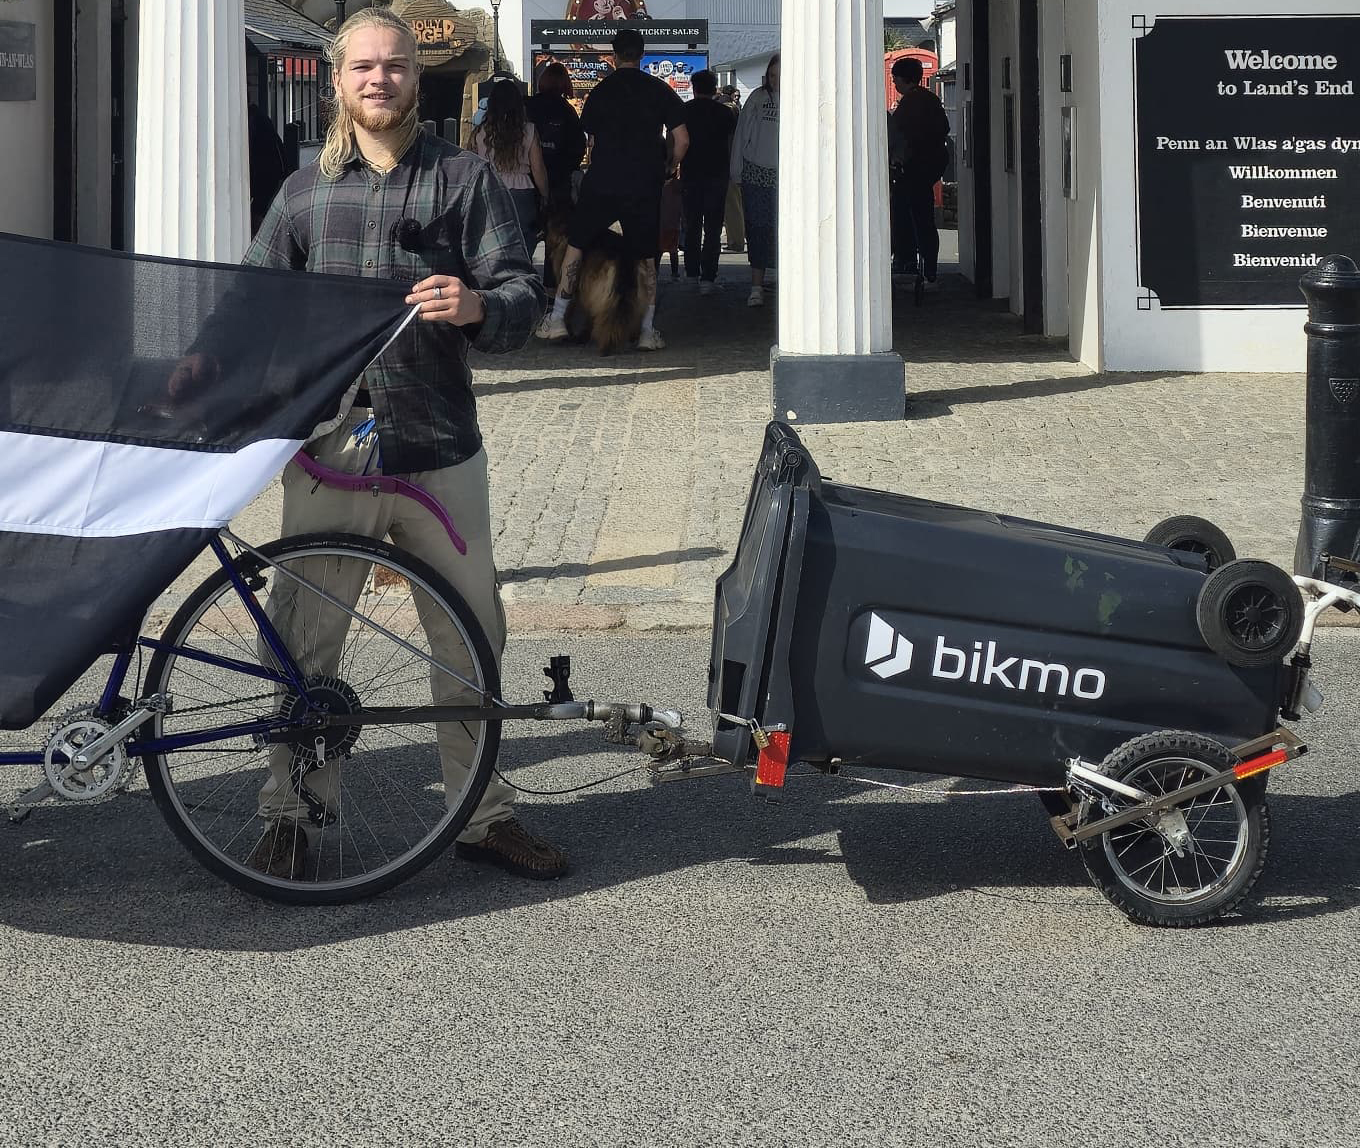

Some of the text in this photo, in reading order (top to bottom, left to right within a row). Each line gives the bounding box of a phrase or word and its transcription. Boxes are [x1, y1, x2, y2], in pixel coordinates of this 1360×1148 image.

[557, 28, 700, 37] INFORMATION TICKET SALES
[1224, 50, 1338, 70] Welcome
[1217, 80, 1354, 96] to Land's End
[1156, 136, 1200, 150] Penn
[1205, 139, 1228, 150] an
[1233, 136, 1277, 150] Wlas
[1282, 136, 1327, 153] a'gas
[1229, 166, 1338, 180] Willkommen
[1241, 194, 1327, 208] Benvenuti
[1241, 224, 1328, 238] Bienvenue
[932, 635, 1107, 701] bikmo
